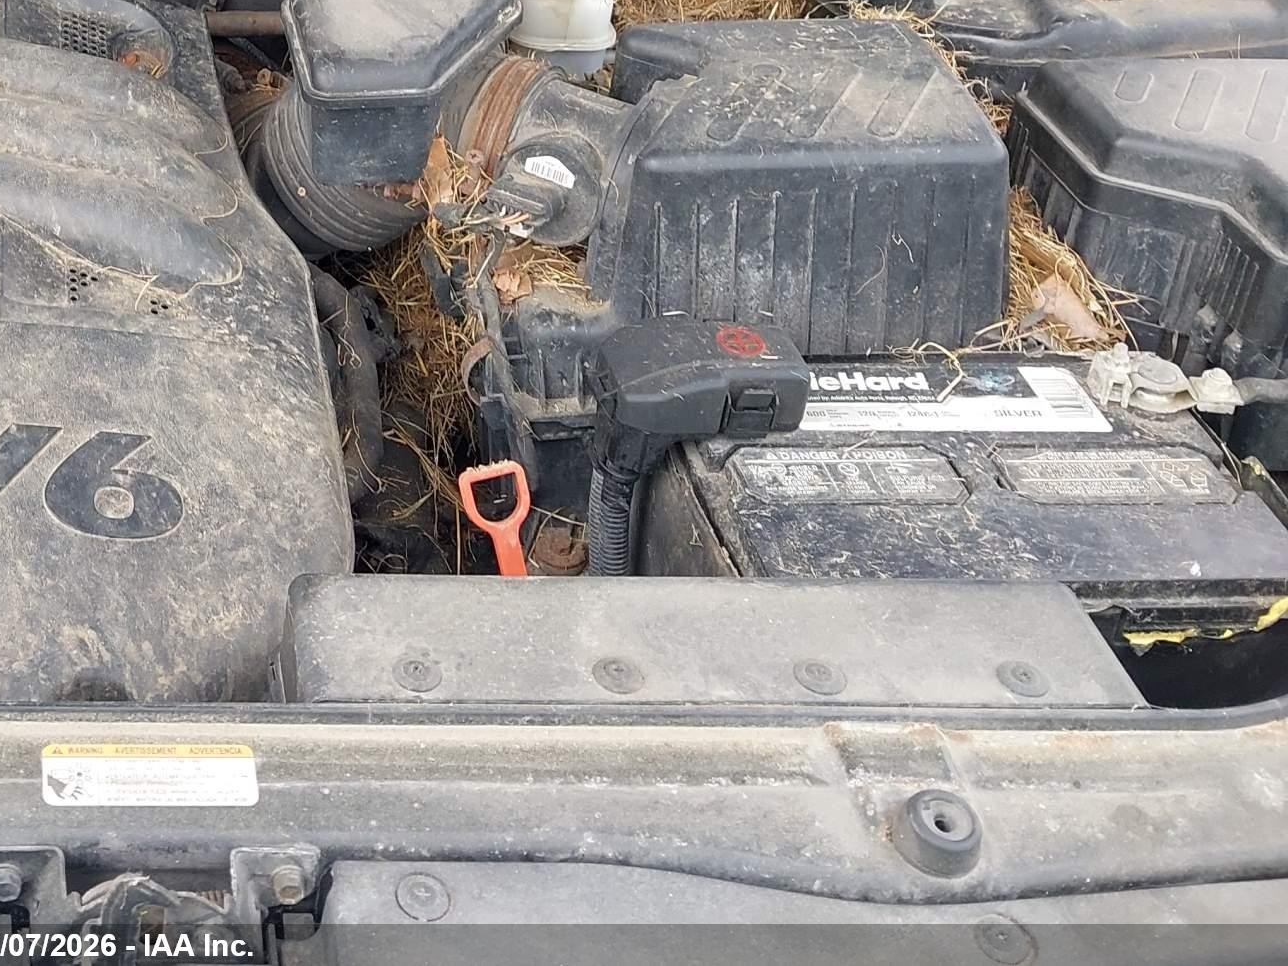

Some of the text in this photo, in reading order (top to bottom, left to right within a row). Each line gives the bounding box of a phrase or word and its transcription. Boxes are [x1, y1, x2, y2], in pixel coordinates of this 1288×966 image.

[808, 371, 930, 392] ieHard
[993, 409, 1043, 418] SILVER
[779, 450, 838, 460] DANGER
[853, 450, 908, 460] POISON
[68, 746, 243, 755] WARNING AVERTISSEMENT ADVERTENCIA
